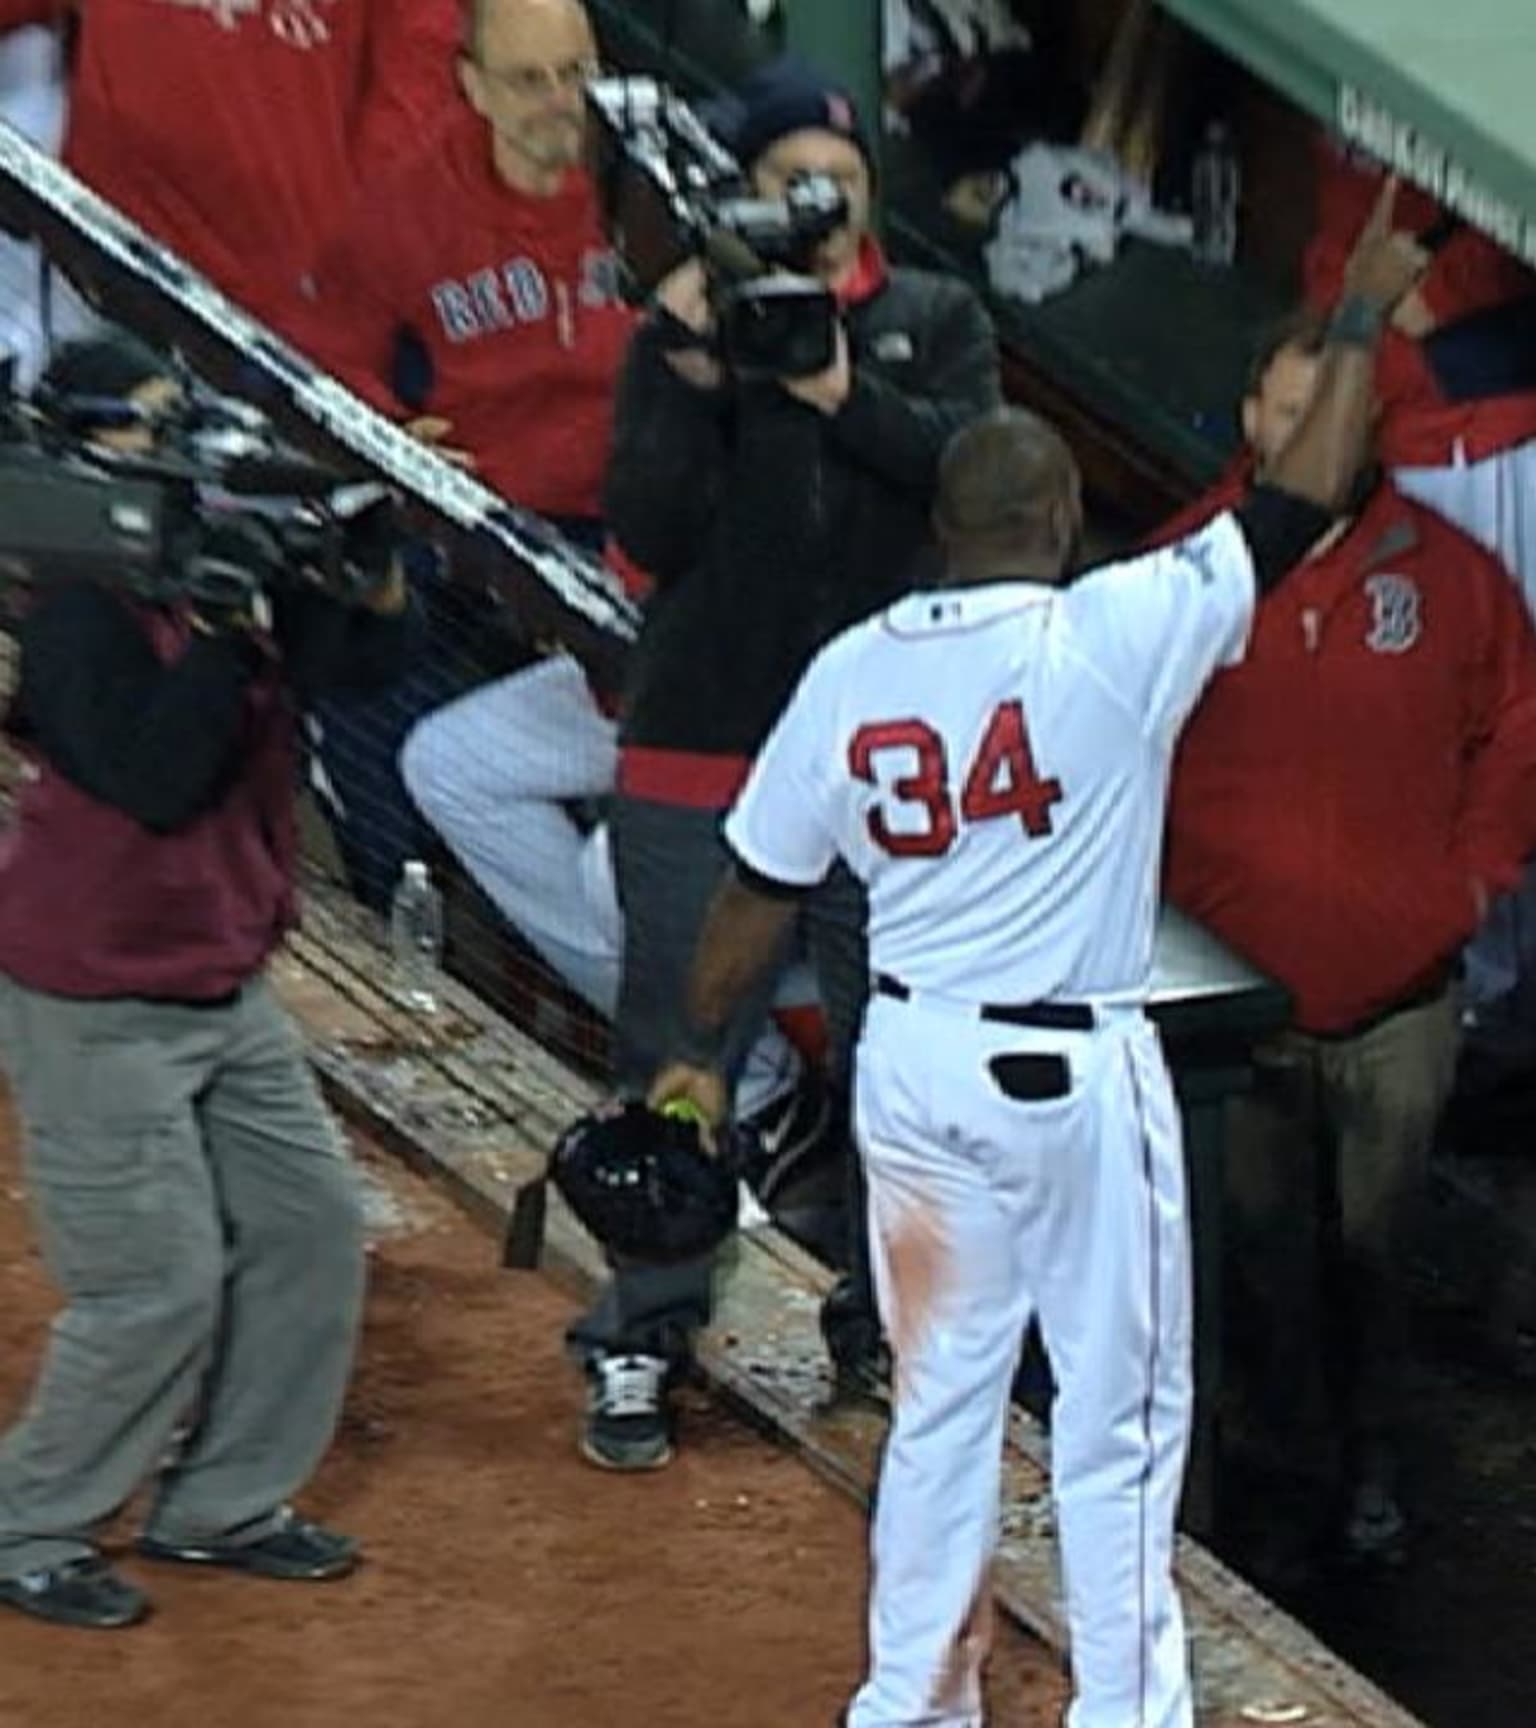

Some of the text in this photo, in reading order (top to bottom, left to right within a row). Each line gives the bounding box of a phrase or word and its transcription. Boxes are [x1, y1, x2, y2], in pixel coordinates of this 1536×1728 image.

[431, 255, 549, 346] RED
[1363, 572, 1422, 655] B
[846, 696, 1066, 860] 34
